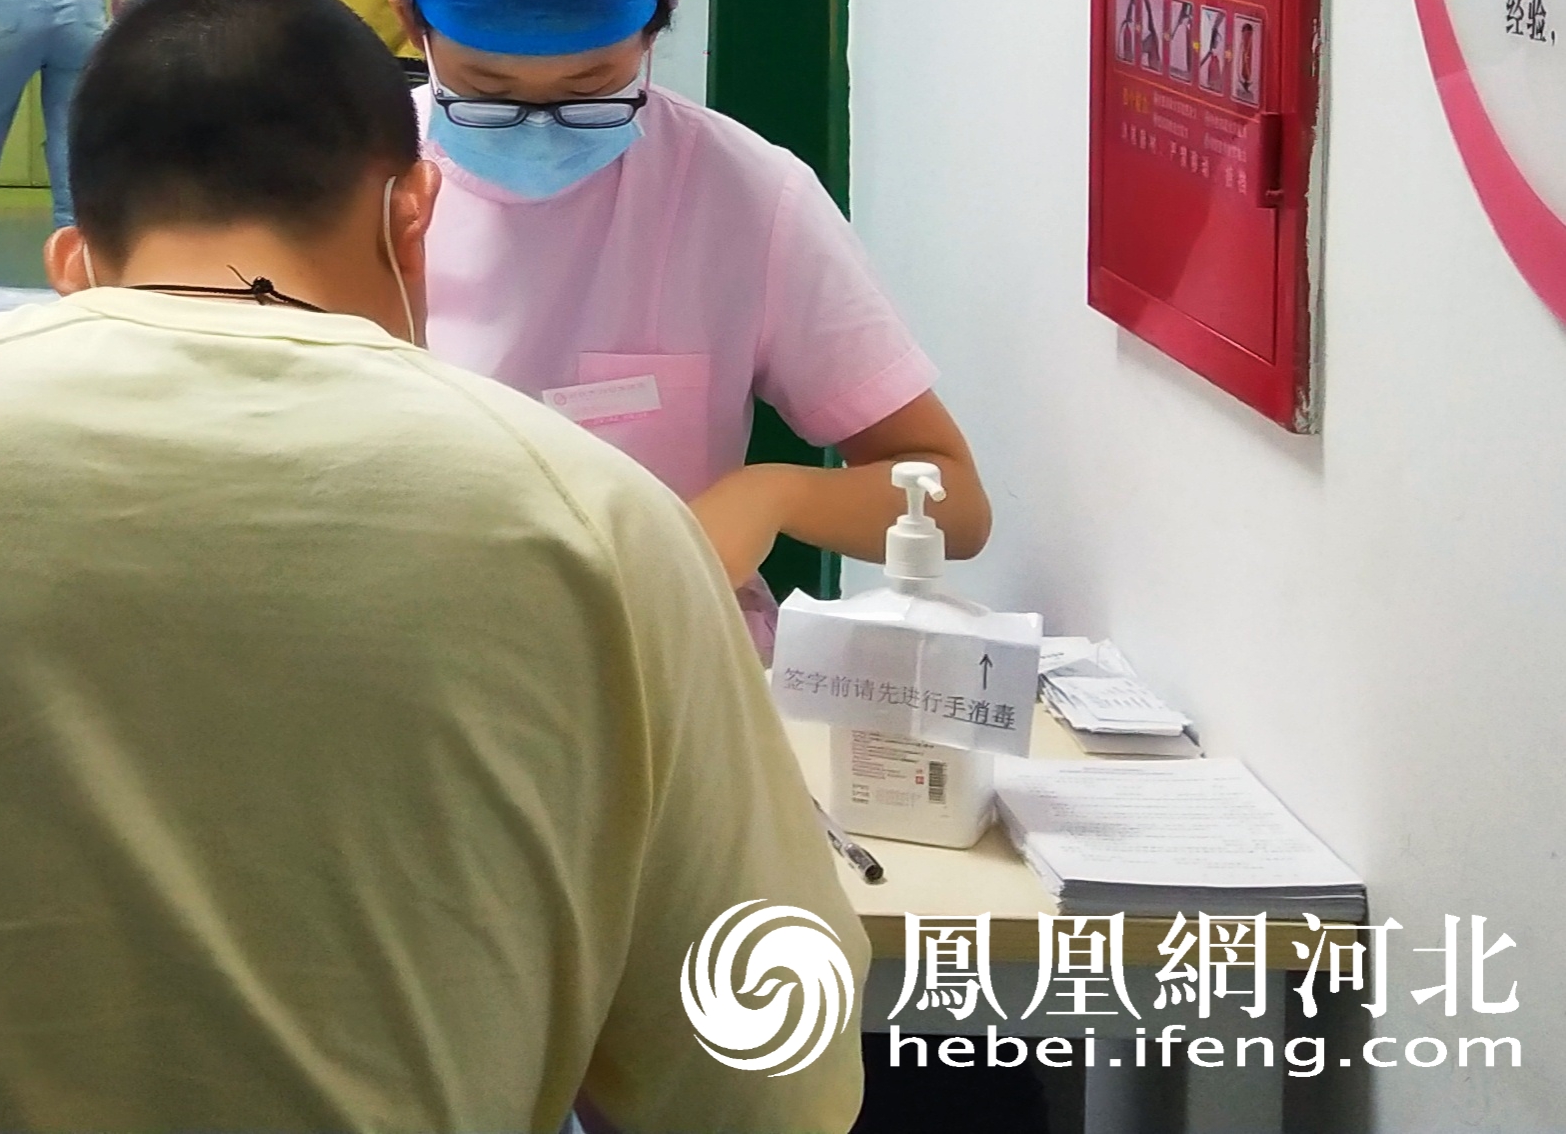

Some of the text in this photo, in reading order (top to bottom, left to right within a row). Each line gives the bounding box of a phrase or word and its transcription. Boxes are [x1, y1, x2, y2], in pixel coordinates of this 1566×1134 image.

[784, 667, 1017, 730] 签字前请先进行手消毒
